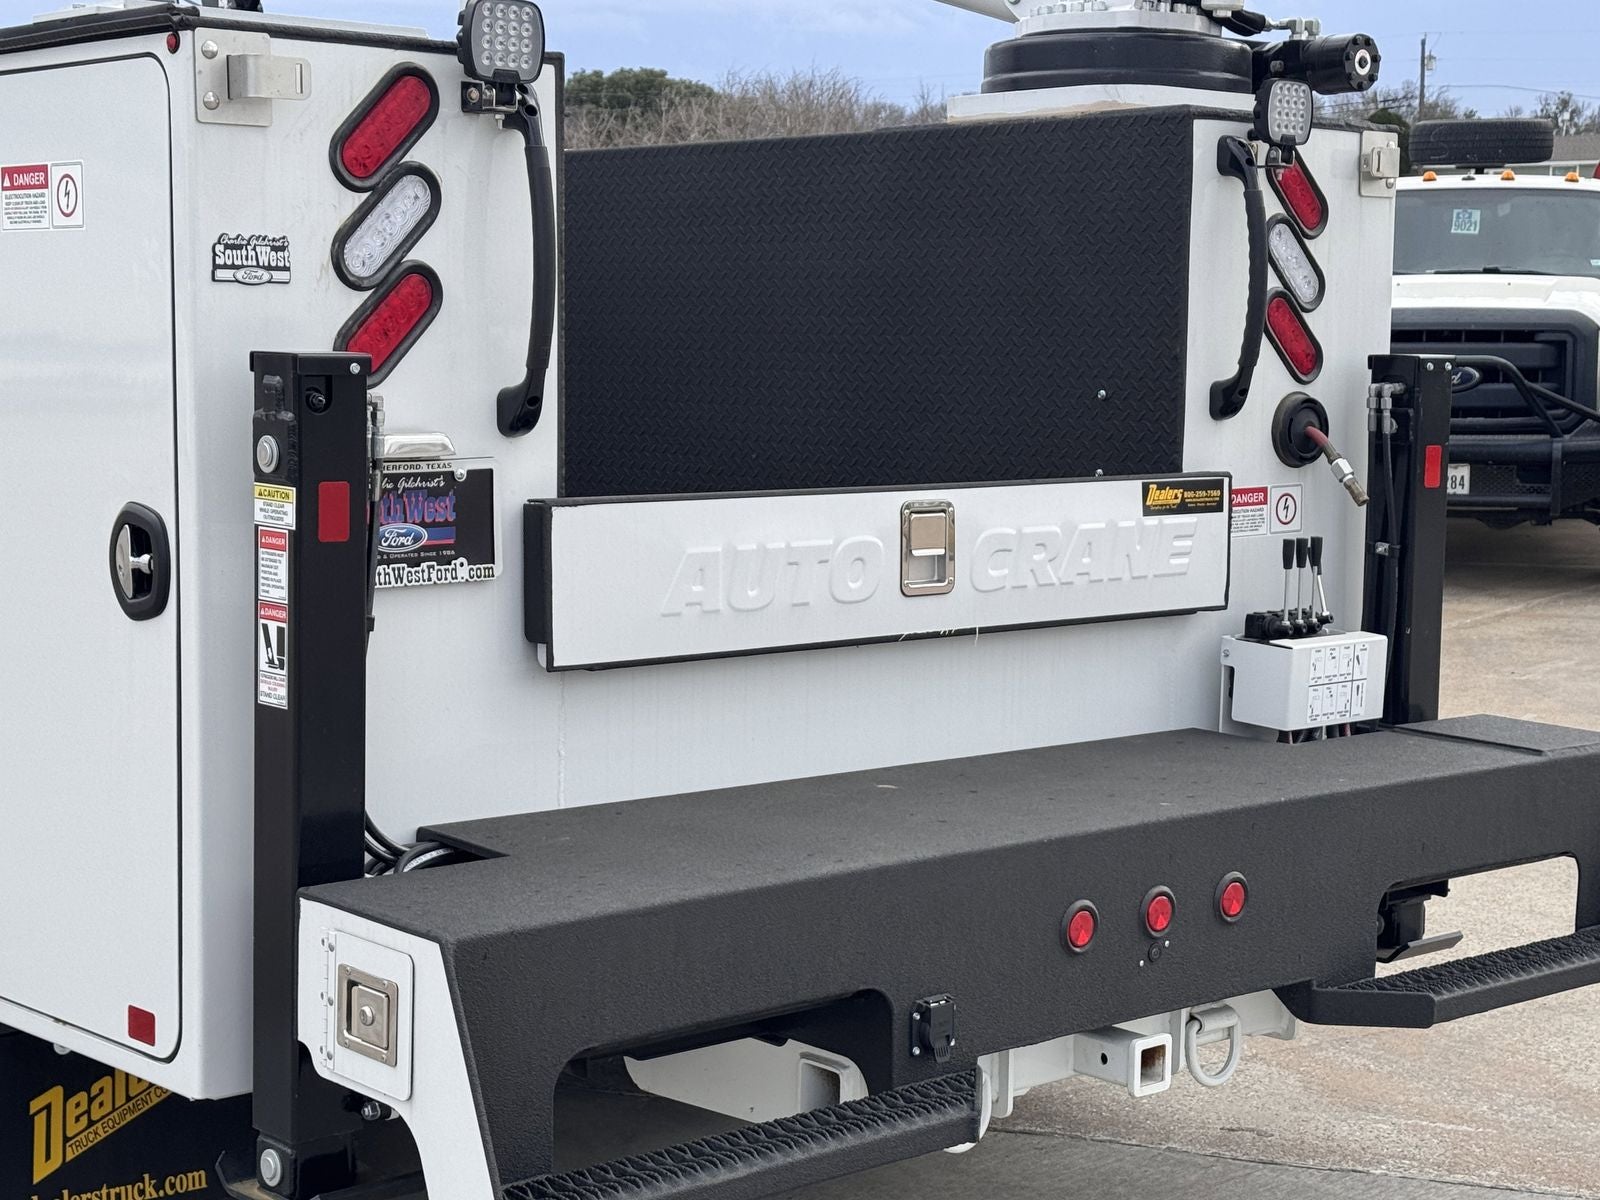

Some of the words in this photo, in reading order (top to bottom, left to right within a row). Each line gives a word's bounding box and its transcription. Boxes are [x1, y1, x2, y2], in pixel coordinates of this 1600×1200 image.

[13, 172, 46, 187] DANGER
[1453, 220, 1478, 232] 9021
[214, 243, 290, 268] SouthWest
[241, 269, 264, 281] Ford
[426, 462, 452, 470] TEXAS
[1449, 474, 1465, 490] 84
[262, 488, 290, 500] CAUTION
[1146, 483, 1184, 506] Dealers
[1232, 492, 1265, 504] DANGER
[379, 489, 457, 525] thWest
[265, 536, 285, 545] DANGER
[381, 528, 415, 546] Ford
[661, 534, 886, 617] AUTO
[970, 516, 1198, 592] CRANE
[376, 562, 496, 587] thWestFord.com
[265, 607, 287, 618] DANGER
[68, 1126, 102, 1156] TRUCK
[100, 1090, 155, 1134] EQUIPMENT
